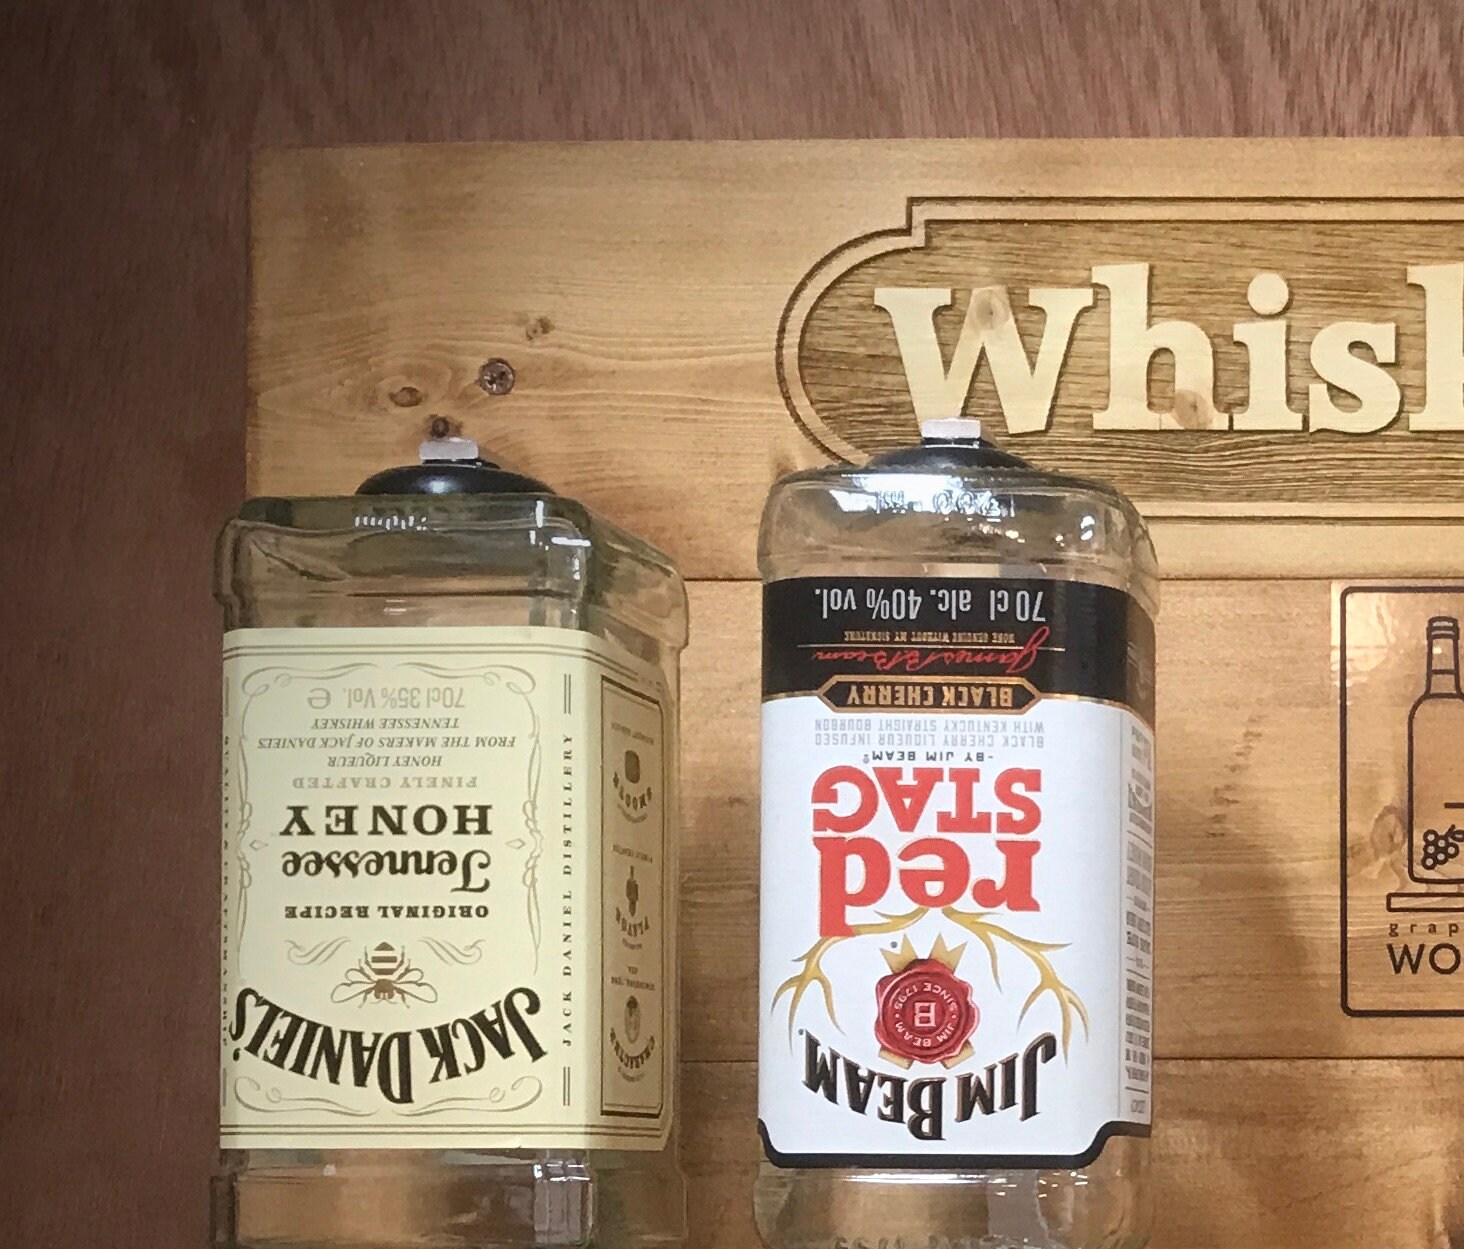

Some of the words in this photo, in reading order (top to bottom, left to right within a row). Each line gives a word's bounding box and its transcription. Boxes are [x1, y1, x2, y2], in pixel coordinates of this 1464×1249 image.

[814, 588, 856, 619] vol.
[866, 587, 922, 620] 40%
[929, 588, 972, 621] alc.
[843, 630, 891, 642] SIGNATURE
[893, 631, 907, 642] MY
[910, 631, 950, 643] WITHOUT
[342, 687, 376, 709] Vol.
[381, 687, 421, 709] 35%
[427, 687, 465, 709] 70cl
[846, 684, 934, 706] CHERRY
[940, 685, 1013, 708] BLACK
[311, 717, 375, 729] WHISKEY
[379, 717, 460, 729] TENNESSEE
[815, 719, 871, 731] BOURBON
[878, 719, 937, 732] STRAIGHT
[943, 720, 1007, 733] KENTUCKY
[1013, 721, 1044, 734] WITH
[319, 733, 355, 749] JACK
[356, 737, 374, 748] OF
[377, 736, 437, 748] MAKERS
[441, 736, 470, 748] THE
[476, 736, 516, 748] FROM
[815, 733, 871, 746] INFUSED
[878, 733, 936, 746] LIQUEUR
[942, 734, 994, 747] CHERRY
[1002, 735, 1044, 749] BLACK
[327, 753, 390, 767] LIQUEUR
[391, 755, 442, 767] HONEY
[926, 751, 954, 762] JIM
[292, 776, 391, 789] CRAFTED
[399, 776, 477, 789] FINELY
[563, 734, 573, 876] DISTILLERY
[810, 765, 1042, 834] STAG
[279, 804, 493, 836] HONEY
[281, 849, 491, 894] Tennessee
[812, 836, 1041, 938] red
[284, 906, 369, 919] RECIPE
[377, 905, 489, 919] ORIGINAL
[562, 890, 572, 977] DANIEL
[893, 984, 918, 1010] 1795
[923, 982, 958, 1011] SINCE
[562, 991, 572, 1047] JACK
[914, 1002, 936, 1027] B
[417, 987, 548, 1085] JACK
[895, 1021, 932, 1048] BEAM
[936, 1022, 955, 1043] JIM
[229, 987, 414, 1105] DANIEL'S
[802, 1029, 948, 1141] BEAM
[953, 1031, 1057, 1124] JIM
